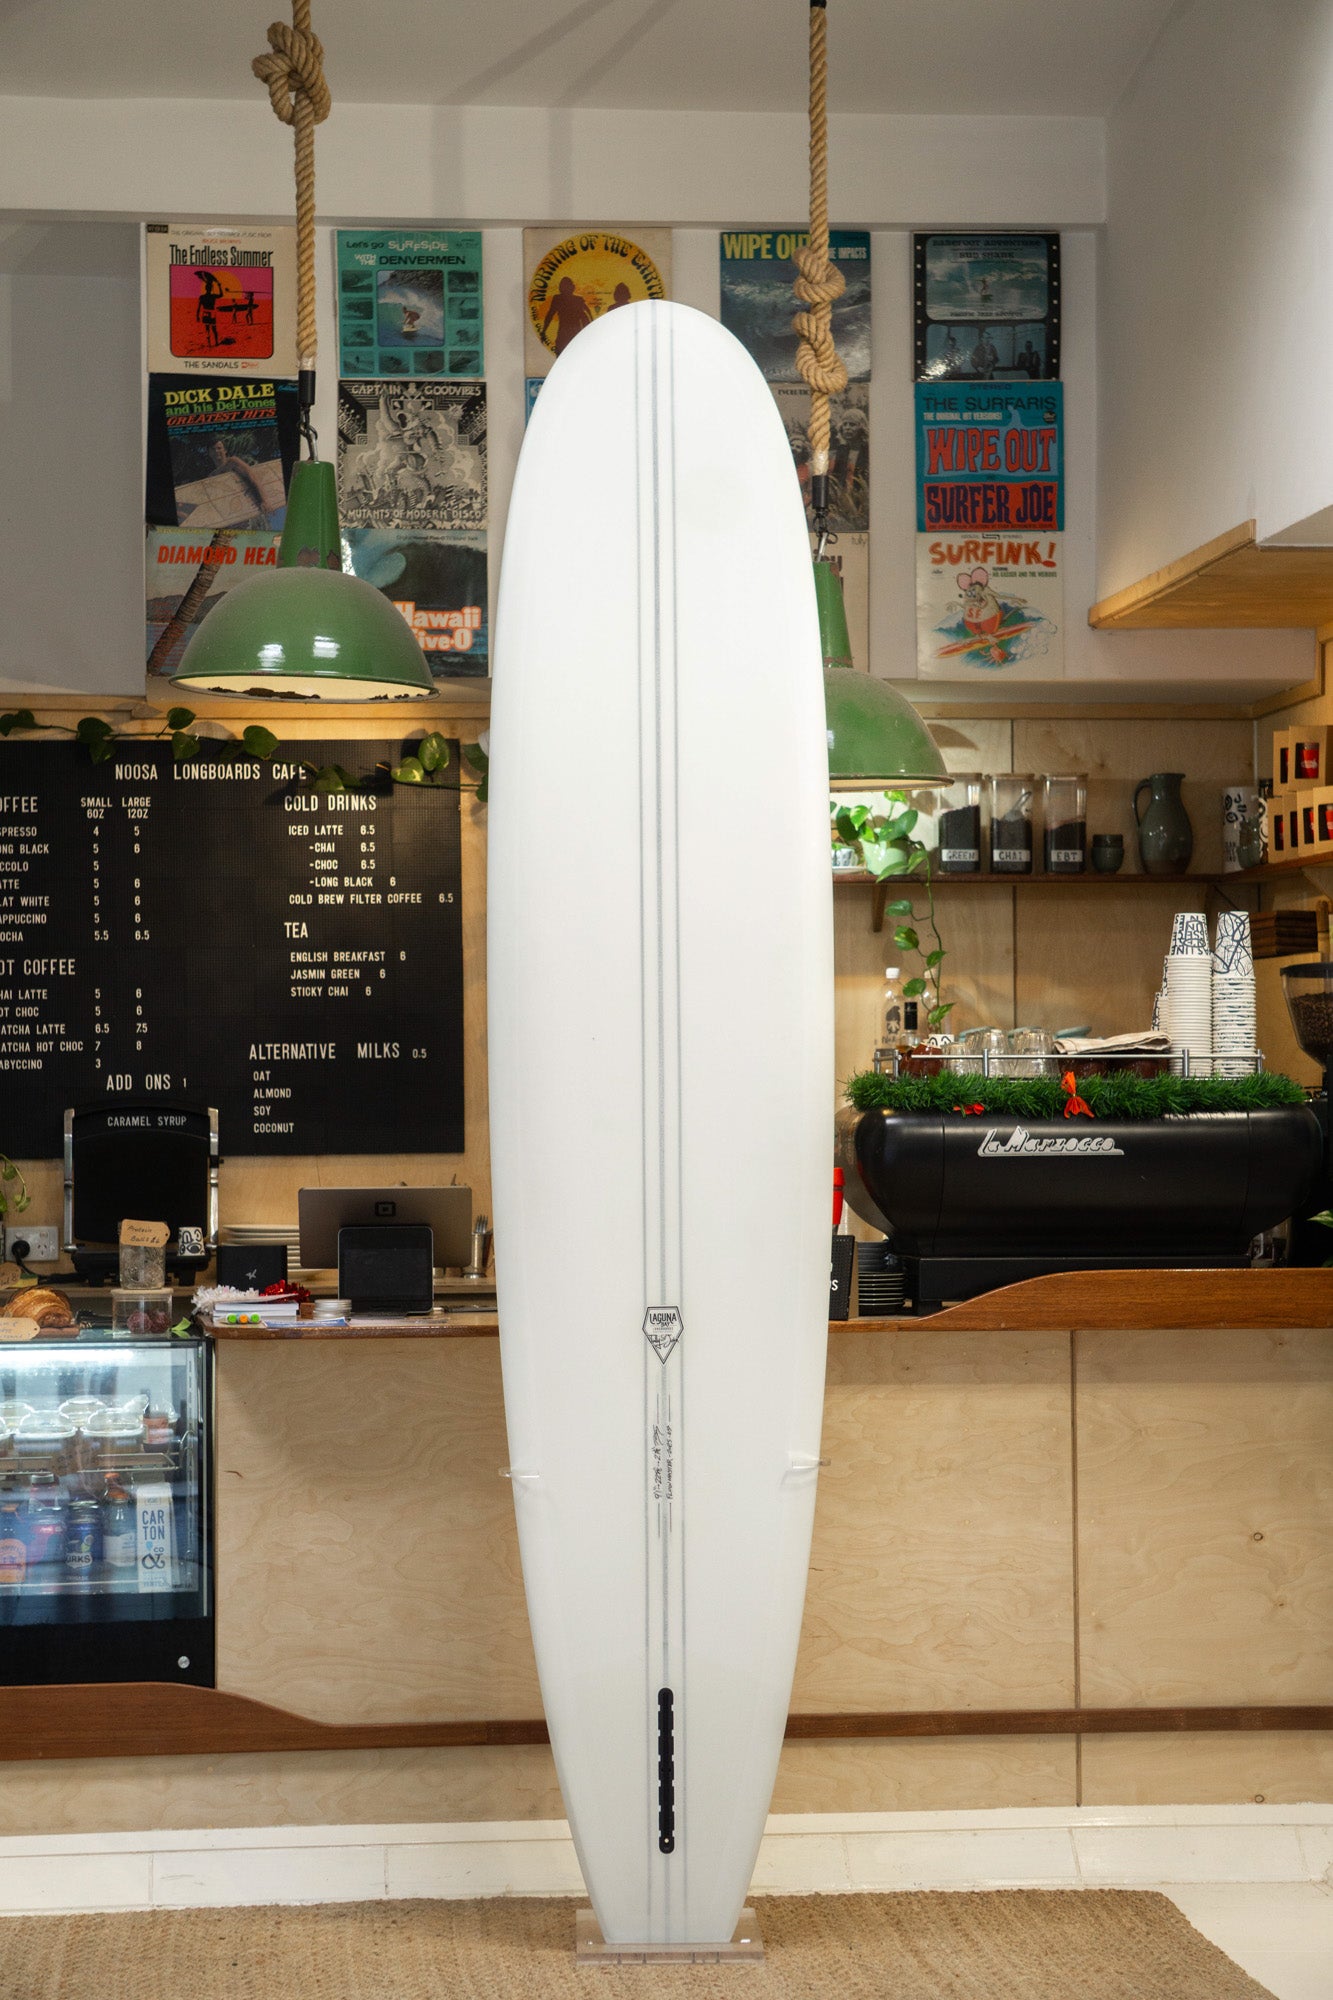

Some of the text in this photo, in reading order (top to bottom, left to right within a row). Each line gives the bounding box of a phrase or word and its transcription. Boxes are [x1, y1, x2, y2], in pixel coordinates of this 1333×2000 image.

[346, 241, 368, 249] Let's
[371, 242, 384, 250] go
[388, 240, 448, 252] SURFSIDE
[723, 234, 773, 259] WIPE
[169, 244, 273, 267] The Endless Summer
[379, 255, 466, 265] DENVERMEN
[531, 240, 578, 302] MORNING
[580, 235, 599, 251] OF
[602, 235, 632, 258] THE
[184, 361, 199, 369] THE
[201, 361, 239, 369] SANDALS
[164, 388, 212, 405] DICK
[217, 383, 275, 400] DALE
[351, 384, 481, 396] CAPTAIN GOODVIBES
[166, 399, 276, 416] and his Del-Tones
[924, 396, 1056, 411] THE SURFARIS
[167, 408, 276, 426] GREATEST HITS
[927, 427, 1056, 475] WIPE OUT
[927, 483, 1054, 524] SURFER JOE
[347, 509, 390, 520] MUTANTS
[406, 509, 447, 520] MODERN
[452, 510, 481, 519] DISCO
[157, 545, 277, 566] DIAMOND HEA
[394, 602, 481, 629] Hawaii
[411, 628, 472, 651] ive-O
[116, 764, 306, 779] NOOSA LONGBOARDS CAFE
[0, 797, 152, 812] FFEE SMALL LARGE
[285, 795, 376, 811] COLD DRINKS
[0, 826, 140, 836] PRESSO 4 5
[289, 825, 375, 835] ICED LATTE 6.5
[0, 844, 141, 853] NG BLACK 5 6
[310, 842, 375, 852] -CHAI 6.5
[945, 849, 976, 861] GREEN
[998, 850, 1022, 861] CHAI
[1056, 851, 1078, 861] EBT
[0, 861, 100, 871] CCOLO 5
[310, 860, 375, 869] -CHOC 6.5
[93, 879, 100, 888] 5
[134, 879, 141, 888] 6
[310, 877, 397, 887] -LONG BLACK 6
[21, 896, 49, 906] WHITE
[93, 896, 100, 905] 5
[134, 896, 141, 905] 6
[289, 893, 453, 904] COLD BREW FILTER COFFEE 6.5
[0, 913, 141, 923] PPUCCINO 5 6
[284, 922, 308, 938] TEA
[0, 931, 149, 941] OCHA 5.5 6.5
[291, 951, 407, 962] ENGLISH BREAKFAST 6
[0, 959, 75, 975] OT COFFEE
[291, 969, 386, 979] JASMIN GREEN 6
[0, 989, 142, 999] HAI LATTE 5 6
[291, 986, 372, 996] STICKY CHAI 6
[0, 1006, 143, 1017] OT CHOC 5 6
[1, 1025, 30, 1034] ATCHA
[37, 1024, 65, 1034] LATTE
[96, 1024, 109, 1033] 6.5
[2, 1041, 142, 1052] ATCHA HOT CHOC 7 8
[250, 1043, 426, 1059] ALTERNATIVE MILKS 0.5
[0, 1059, 101, 1069] ABYCCINO 3
[254, 1071, 270, 1080] OAT
[107, 1075, 132, 1090] ADD
[146, 1074, 170, 1089] ONS
[254, 1089, 291, 1098] ALMOND
[254, 1106, 270, 1116] SOY
[108, 1116, 186, 1126] CARAMEL SYRUP
[254, 1123, 294, 1133] COCONUT
[1002, 1125, 1120, 1155] Marzocco
[649, 1313, 677, 1324] LAGUNA
[142, 1510, 165, 1525] CAR
[142, 1526, 165, 1541] TON
[141, 1553, 166, 1570] &
